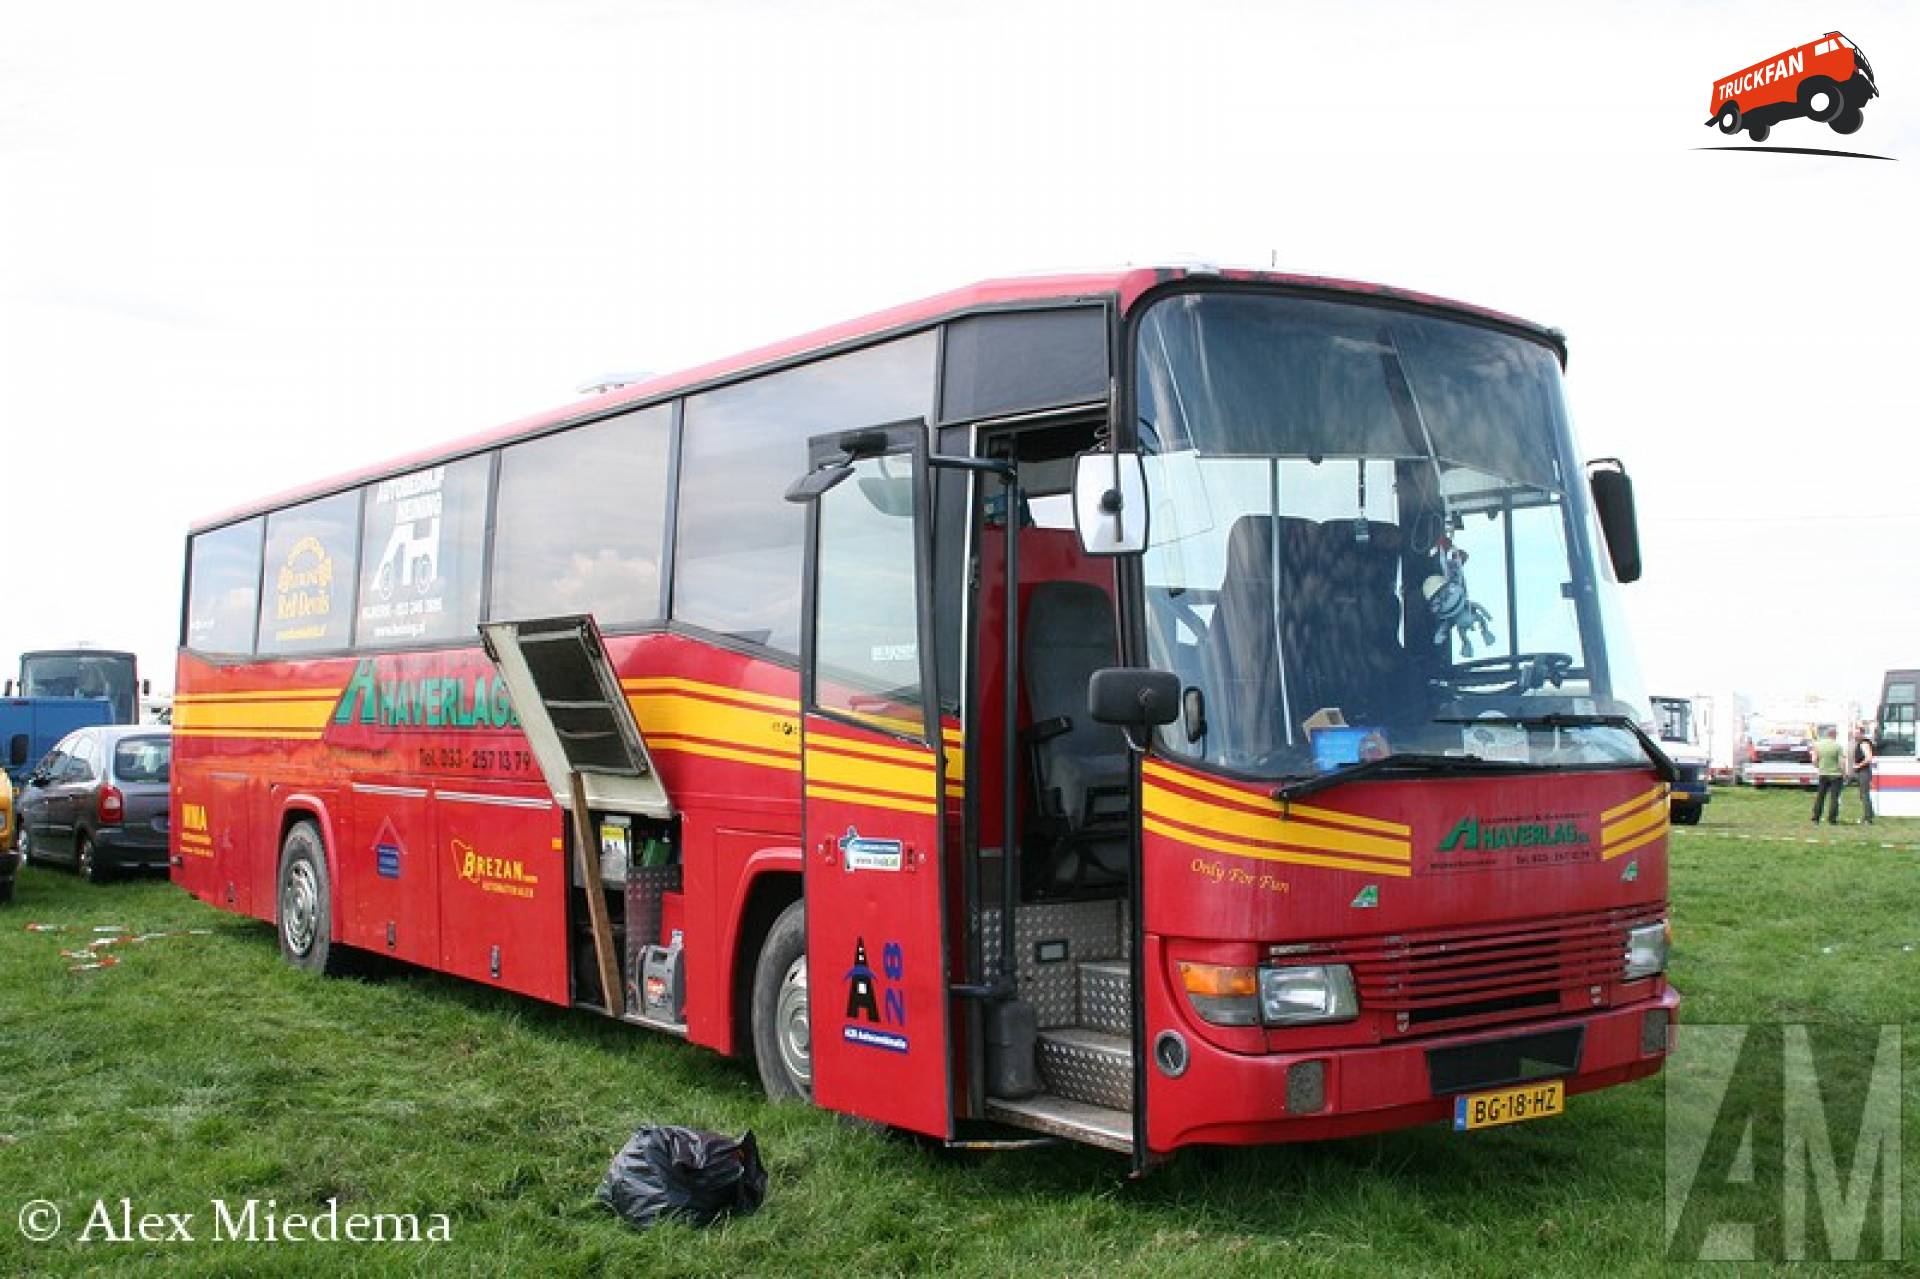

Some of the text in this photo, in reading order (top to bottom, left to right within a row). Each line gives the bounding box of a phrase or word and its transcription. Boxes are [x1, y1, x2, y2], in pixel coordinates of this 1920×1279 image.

[1190, 858, 1290, 894] Only For Fun
[1475, 1087, 1556, 1124] BG-18-HZ
